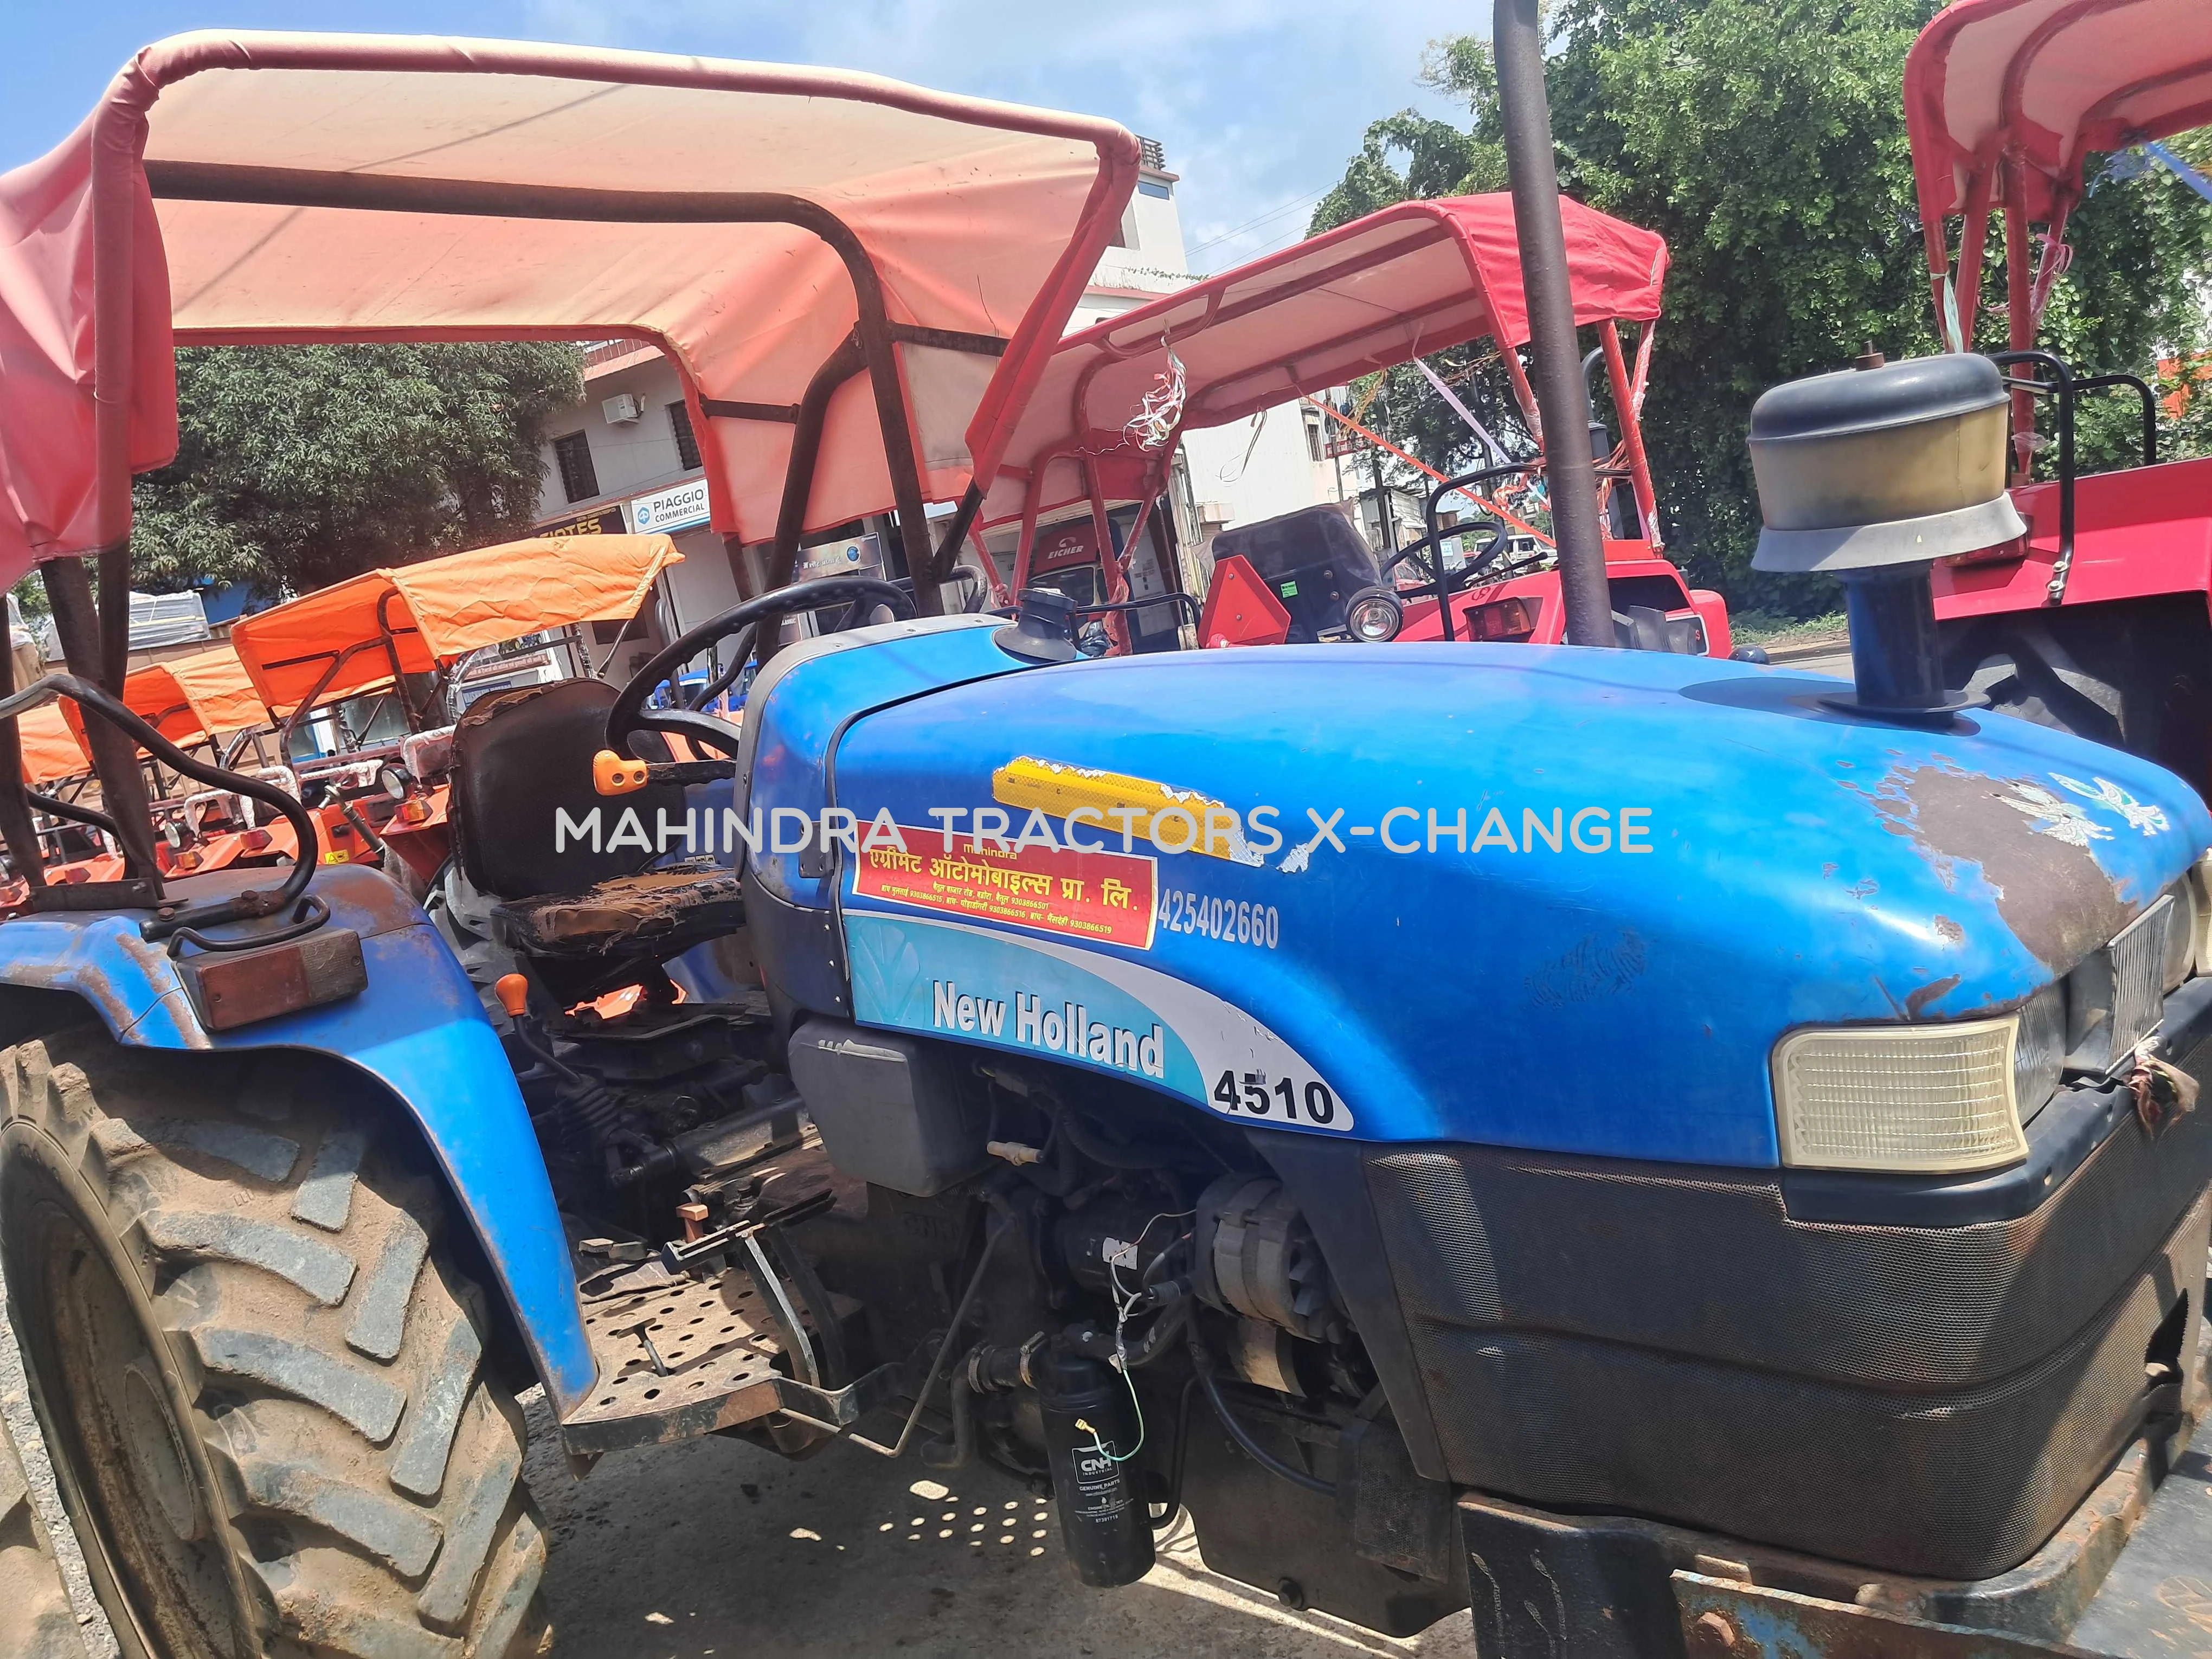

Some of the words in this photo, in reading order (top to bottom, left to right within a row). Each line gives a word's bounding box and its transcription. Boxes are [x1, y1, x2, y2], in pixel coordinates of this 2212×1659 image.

[653, 489, 704, 512] PIAGGIO
[655, 503, 705, 522] COMMERCIAL
[1047, 545, 1084, 560] EICHER
[963, 844, 1018, 860] mhindra
[929, 853, 1053, 896] ऑटोमोबाइल्स
[1011, 897, 1050, 910] 9303866501
[989, 905, 1028, 919] 9303866516,
[1070, 919, 1112, 934] 9303866519
[1159, 889, 1280, 949] 425402660
[933, 980, 1006, 1037] New
[1015, 991, 1164, 1079] Holland
[1214, 1070, 1334, 1124] 4510
[1081, 1451, 1112, 1471] CNH
[1083, 1467, 1113, 1476] INDUSTRIAL
[1104, 1479, 1120, 1489] PARTS
